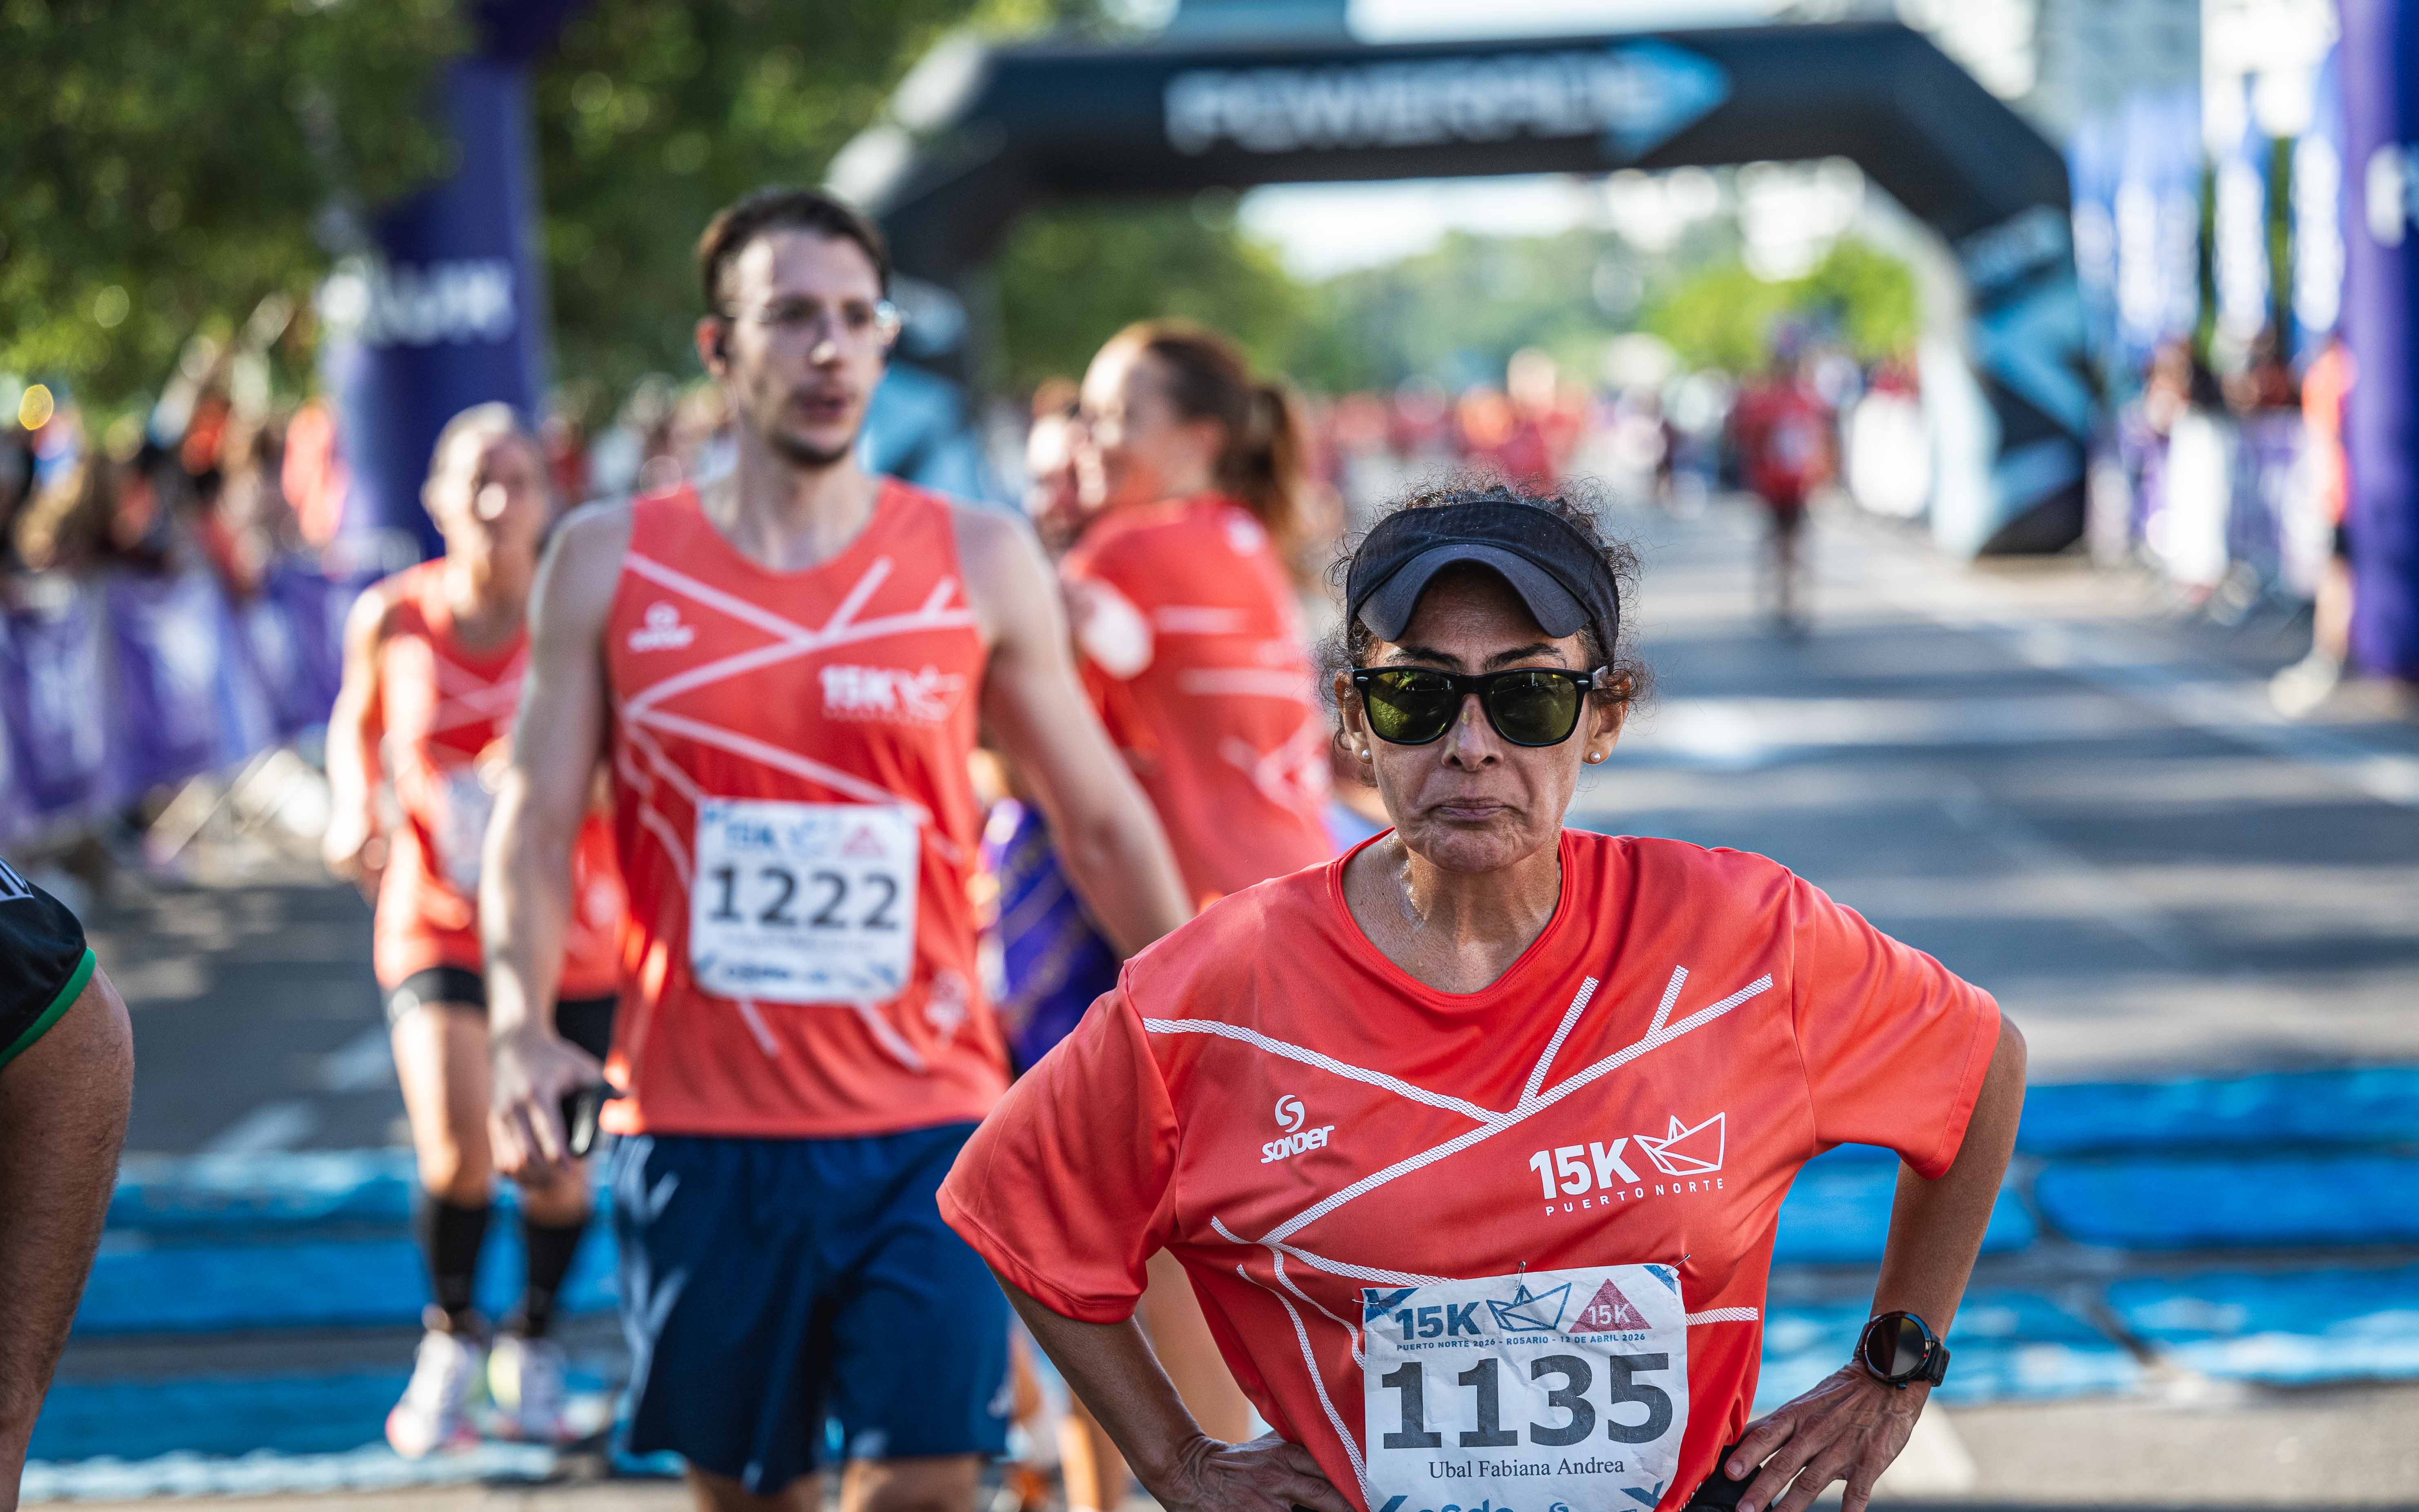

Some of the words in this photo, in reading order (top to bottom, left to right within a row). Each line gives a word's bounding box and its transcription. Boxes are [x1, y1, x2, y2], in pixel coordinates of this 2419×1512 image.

[709, 864, 899, 930] 1222
[1529, 1137, 1641, 1199] 15K
[1546, 1188, 1644, 1216] PUERTO
[1655, 1178, 1724, 1196] NORTE
[1395, 1301, 1482, 1340] 15K
[1586, 1304, 1631, 1325] 15K
[1397, 1342, 1434, 1351] PUERTO
[1438, 1340, 1469, 1348] NORTE
[1473, 1339, 1496, 1347] 2026
[1507, 1336, 1549, 1345] ROSARIO
[1560, 1335, 1570, 1343] 12
[1574, 1335, 1587, 1343] DE
[1590, 1334, 1619, 1343] ABRIL
[1623, 1333, 1646, 1341] 2026
[1382, 1352, 1673, 1449] 1135
[1428, 1460, 1473, 1478] Ubal
[1478, 1459, 1551, 1477] Fabiana
[1556, 1457, 1625, 1475] Andrea
